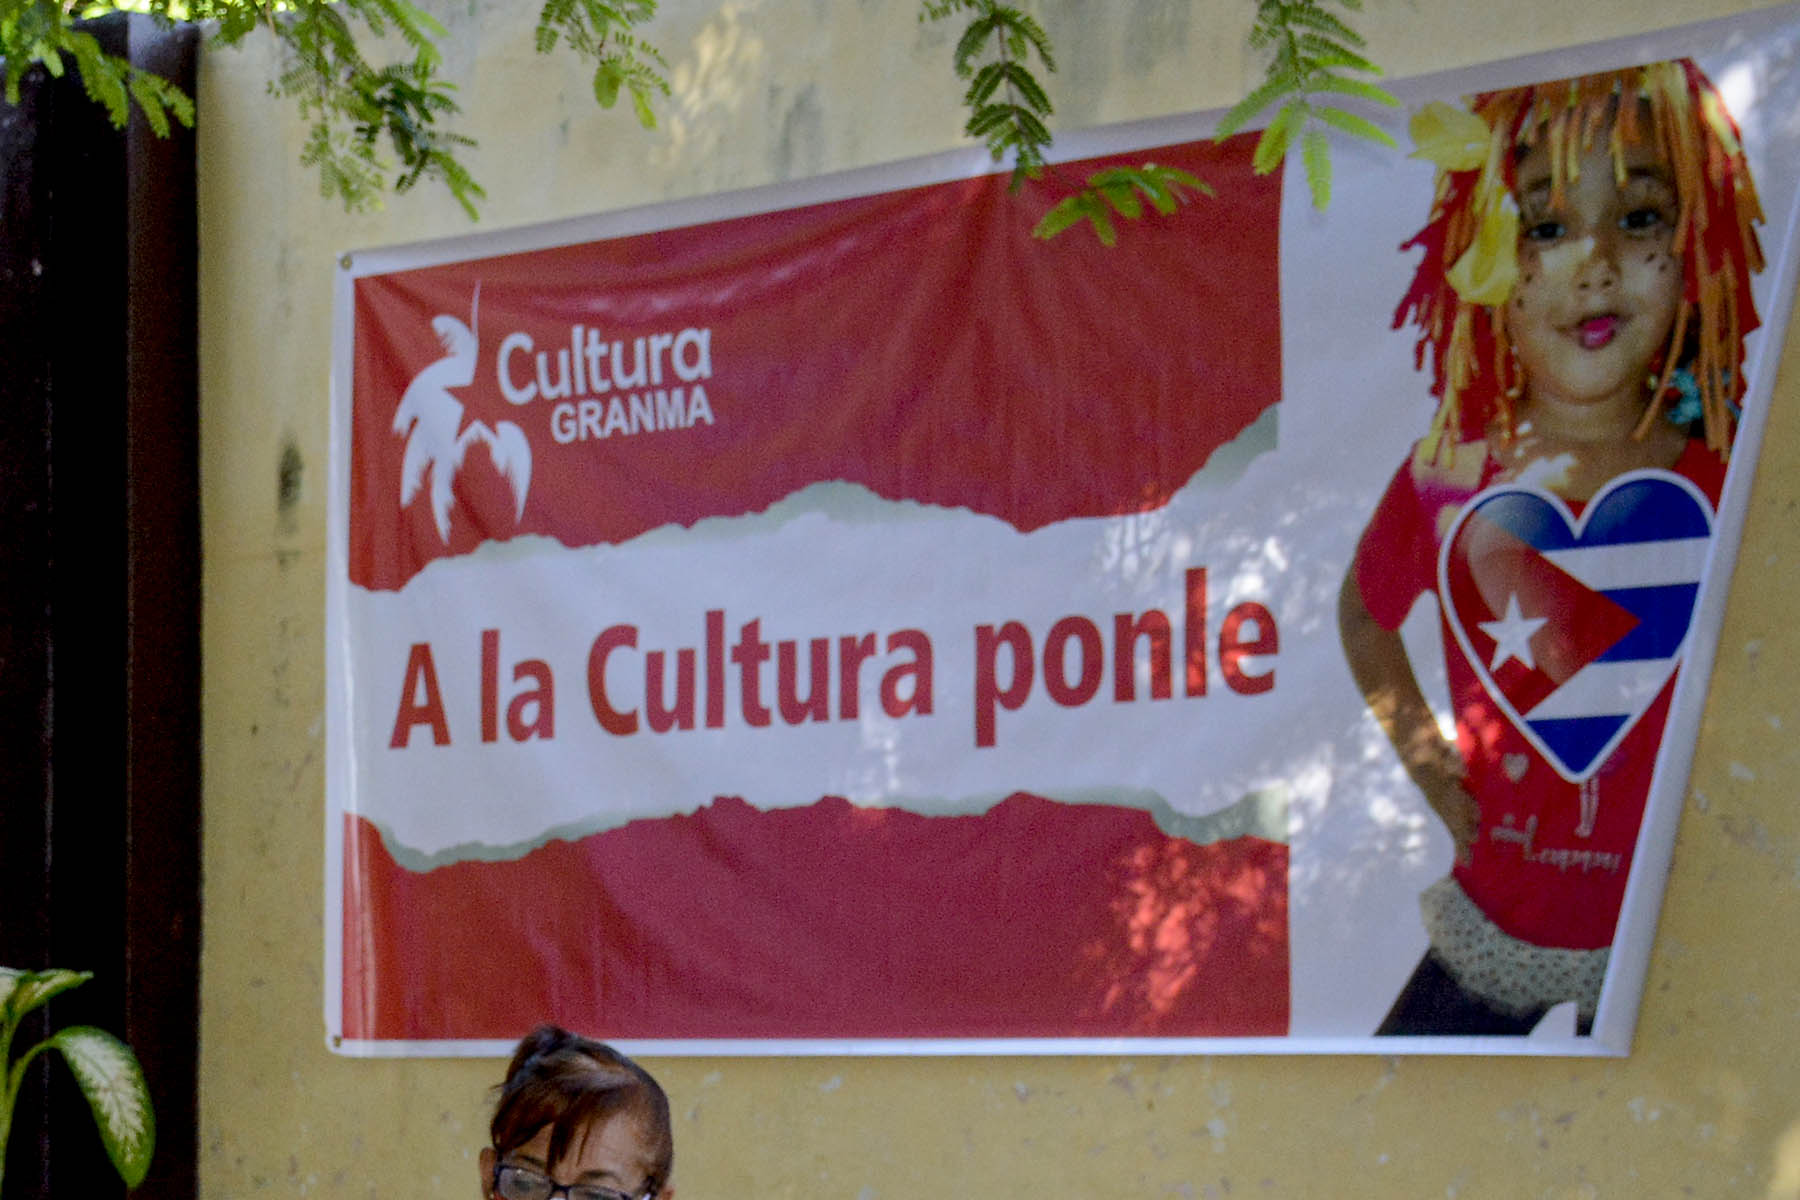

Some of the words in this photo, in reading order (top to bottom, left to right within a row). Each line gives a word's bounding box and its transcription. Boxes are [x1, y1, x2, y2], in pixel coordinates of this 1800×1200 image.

[497, 324, 714, 405] Cultura
[551, 384, 715, 444] GRANMA
[389, 643, 452, 750] A
[479, 629, 556, 744] la
[587, 609, 934, 737] Cultura
[973, 566, 1280, 749] ponle
